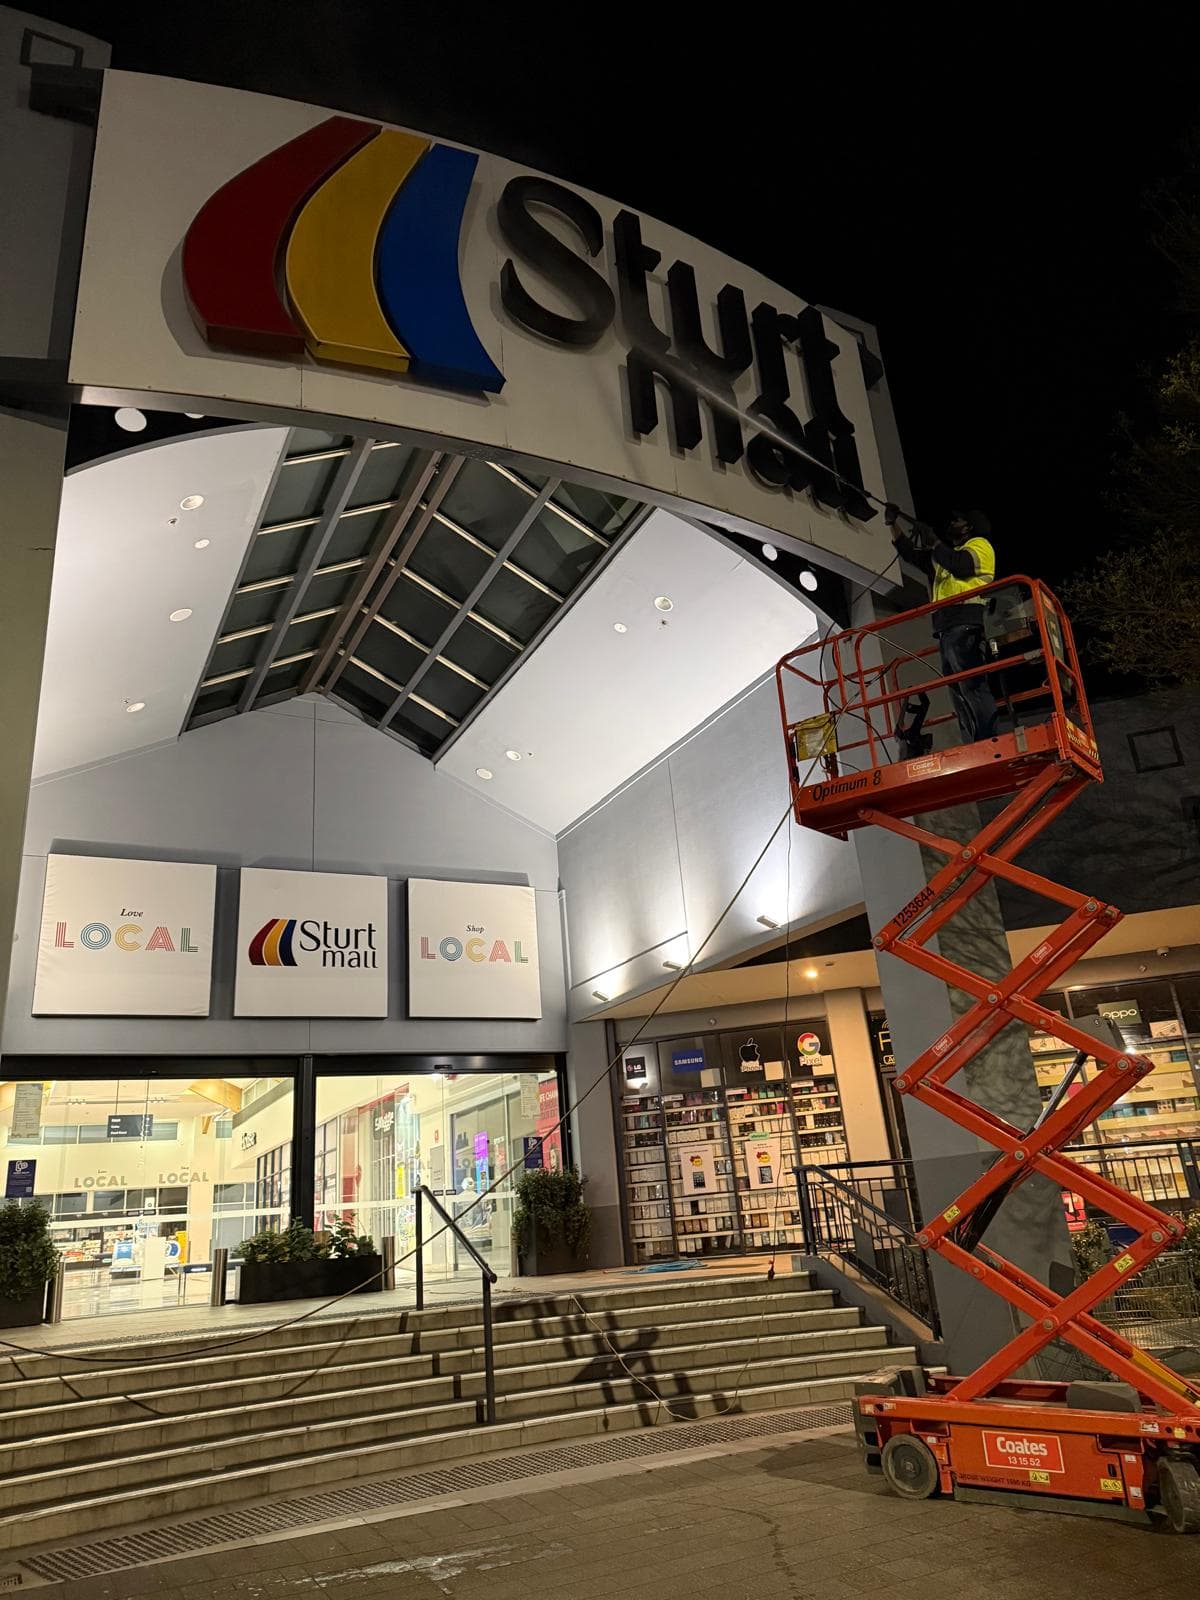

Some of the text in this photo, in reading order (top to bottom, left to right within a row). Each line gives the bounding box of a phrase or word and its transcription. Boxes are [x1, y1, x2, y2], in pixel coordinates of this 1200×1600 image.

[497, 175, 854, 437] Sturt
[626, 346, 878, 521] mall
[812, 769, 882, 802] Optimum 8
[120, 908, 144, 918] Love
[893, 887, 935, 928] 1253644
[55, 921, 199, 953] LOCAL
[300, 920, 377, 951] Sturt
[466, 924, 485, 934] Shop
[323, 950, 379, 968] mall
[420, 936, 529, 963] LOCAL
[673, 1057, 703, 1066] SAMSUNG
[800, 1054, 823, 1066] Pixel
[74, 1175, 128, 1188] LOCAL
[157, 1172, 209, 1184] LOCAL
[996, 1436, 1048, 1456] Coates
[1008, 1456, 1041, 1467] 13 15 52
